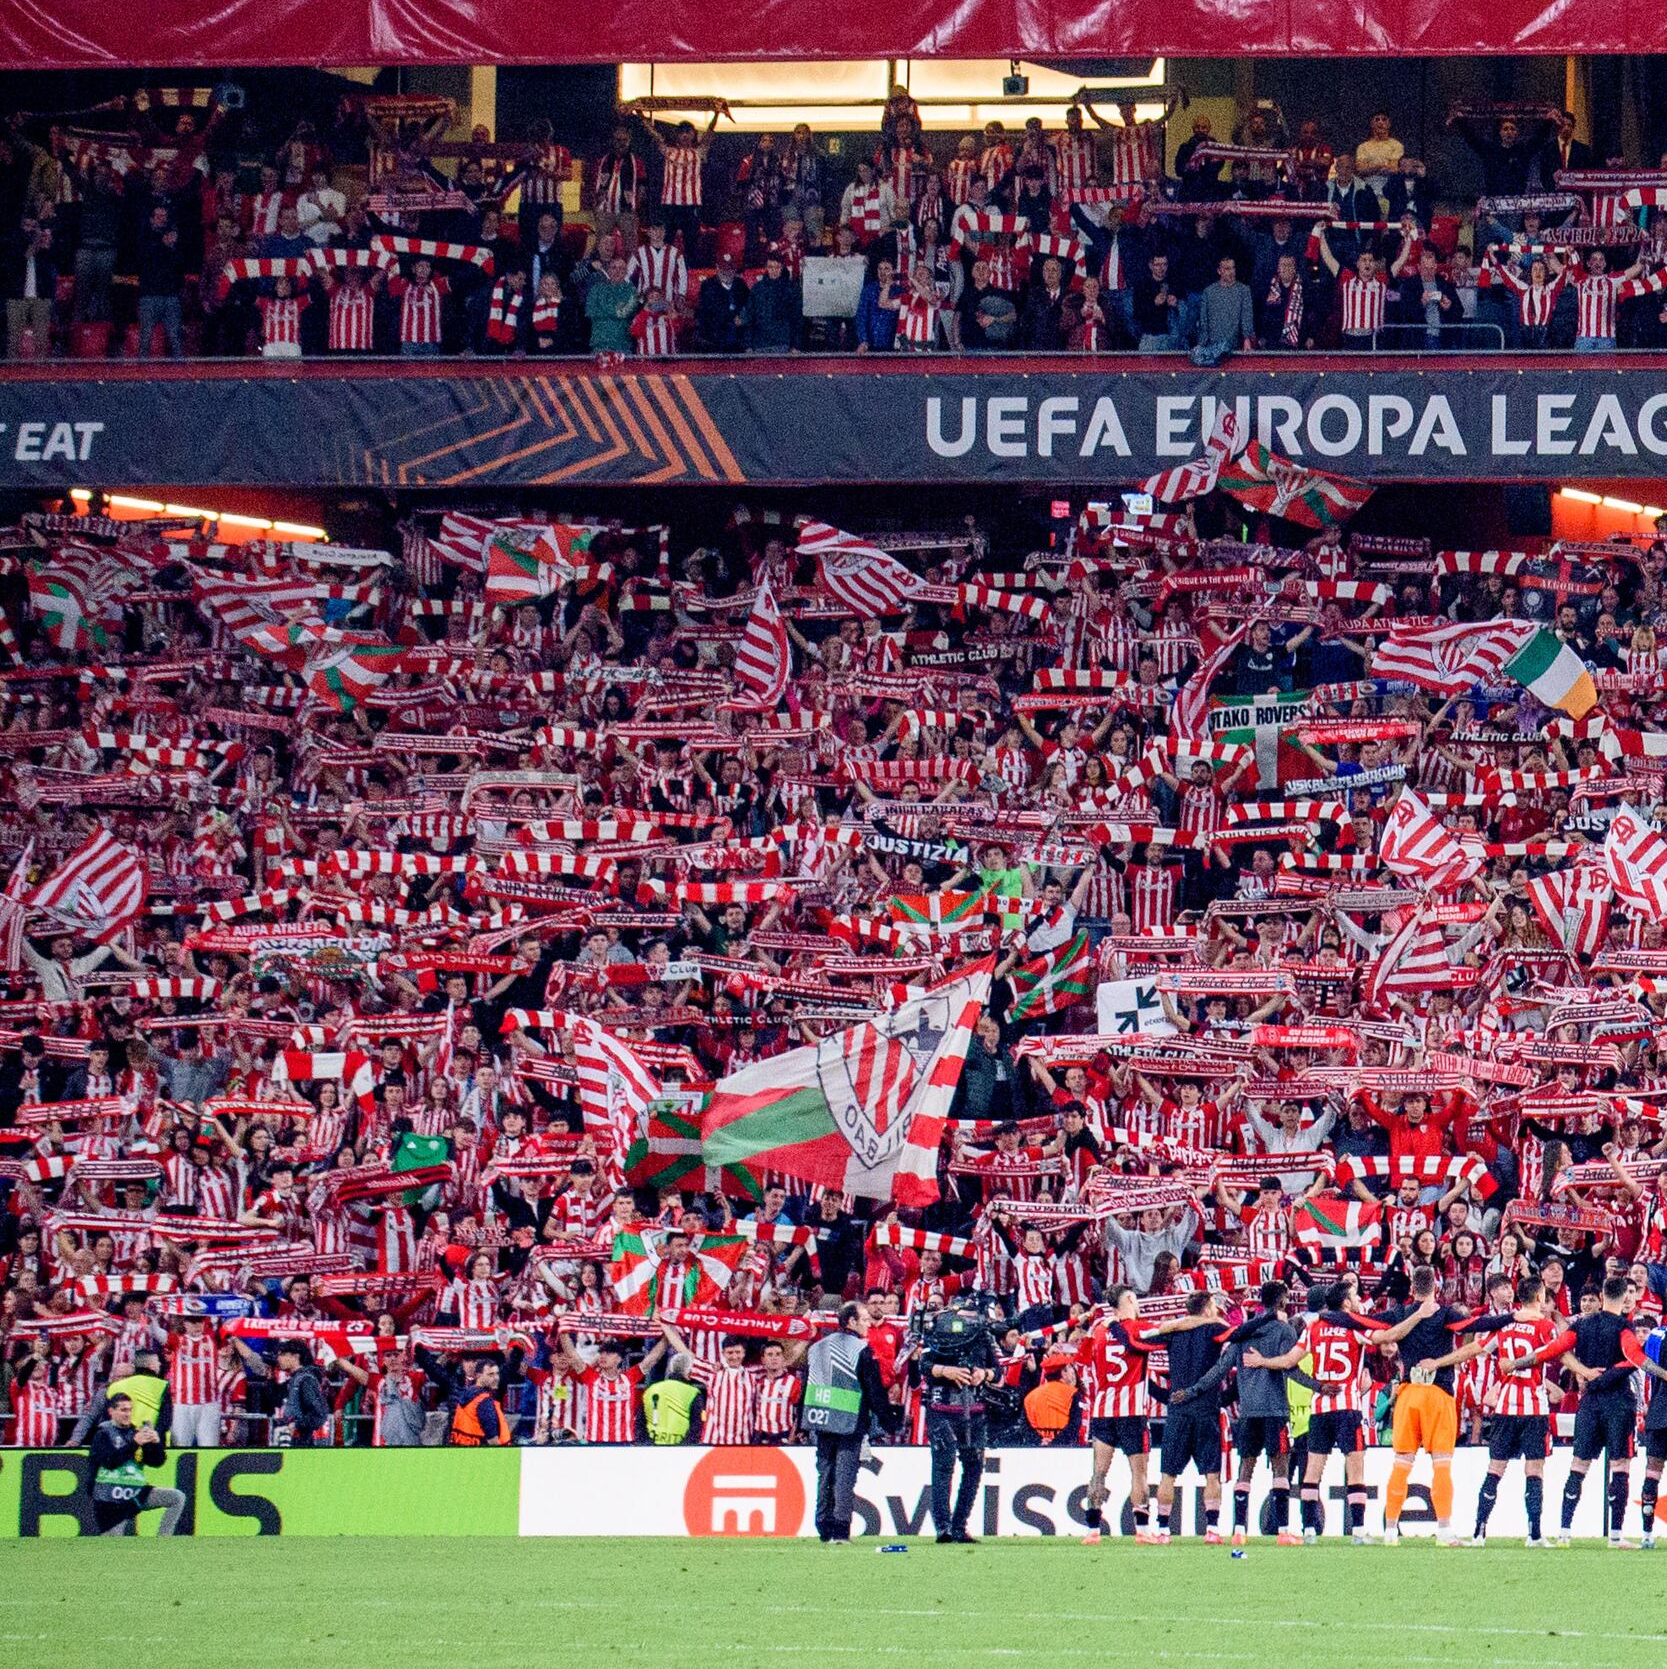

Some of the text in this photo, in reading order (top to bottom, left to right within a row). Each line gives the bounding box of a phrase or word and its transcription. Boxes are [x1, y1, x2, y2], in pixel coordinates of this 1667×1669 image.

[928, 398, 1132, 457] UEFA
[1158, 395, 1467, 457] EUROPA
[17, 424, 104, 462] EAT
[911, 649, 998, 665] ATHLETIC CLUB
[1450, 732, 1544, 743] ATHLETIC CLUB
[868, 836, 969, 864] JUSTIZIA
[233, 925, 269, 936] AUPA
[410, 953, 507, 968] ATHLETIC CLUB
[670, 966, 699, 974] CLUB
[705, 1015, 793, 1026] THLETIC CLUB
[1108, 1046, 1168, 1059] ATHLETIC
[1532, 1045, 1600, 1060] Athletic Club
[683, 1314, 784, 1333] ATHLETIC CLUB
[1106, 1344, 1128, 1383] 5
[1316, 1341, 1352, 1381] 15
[1503, 1336, 1535, 1377] 12
[816, 1389, 832, 1404] HB
